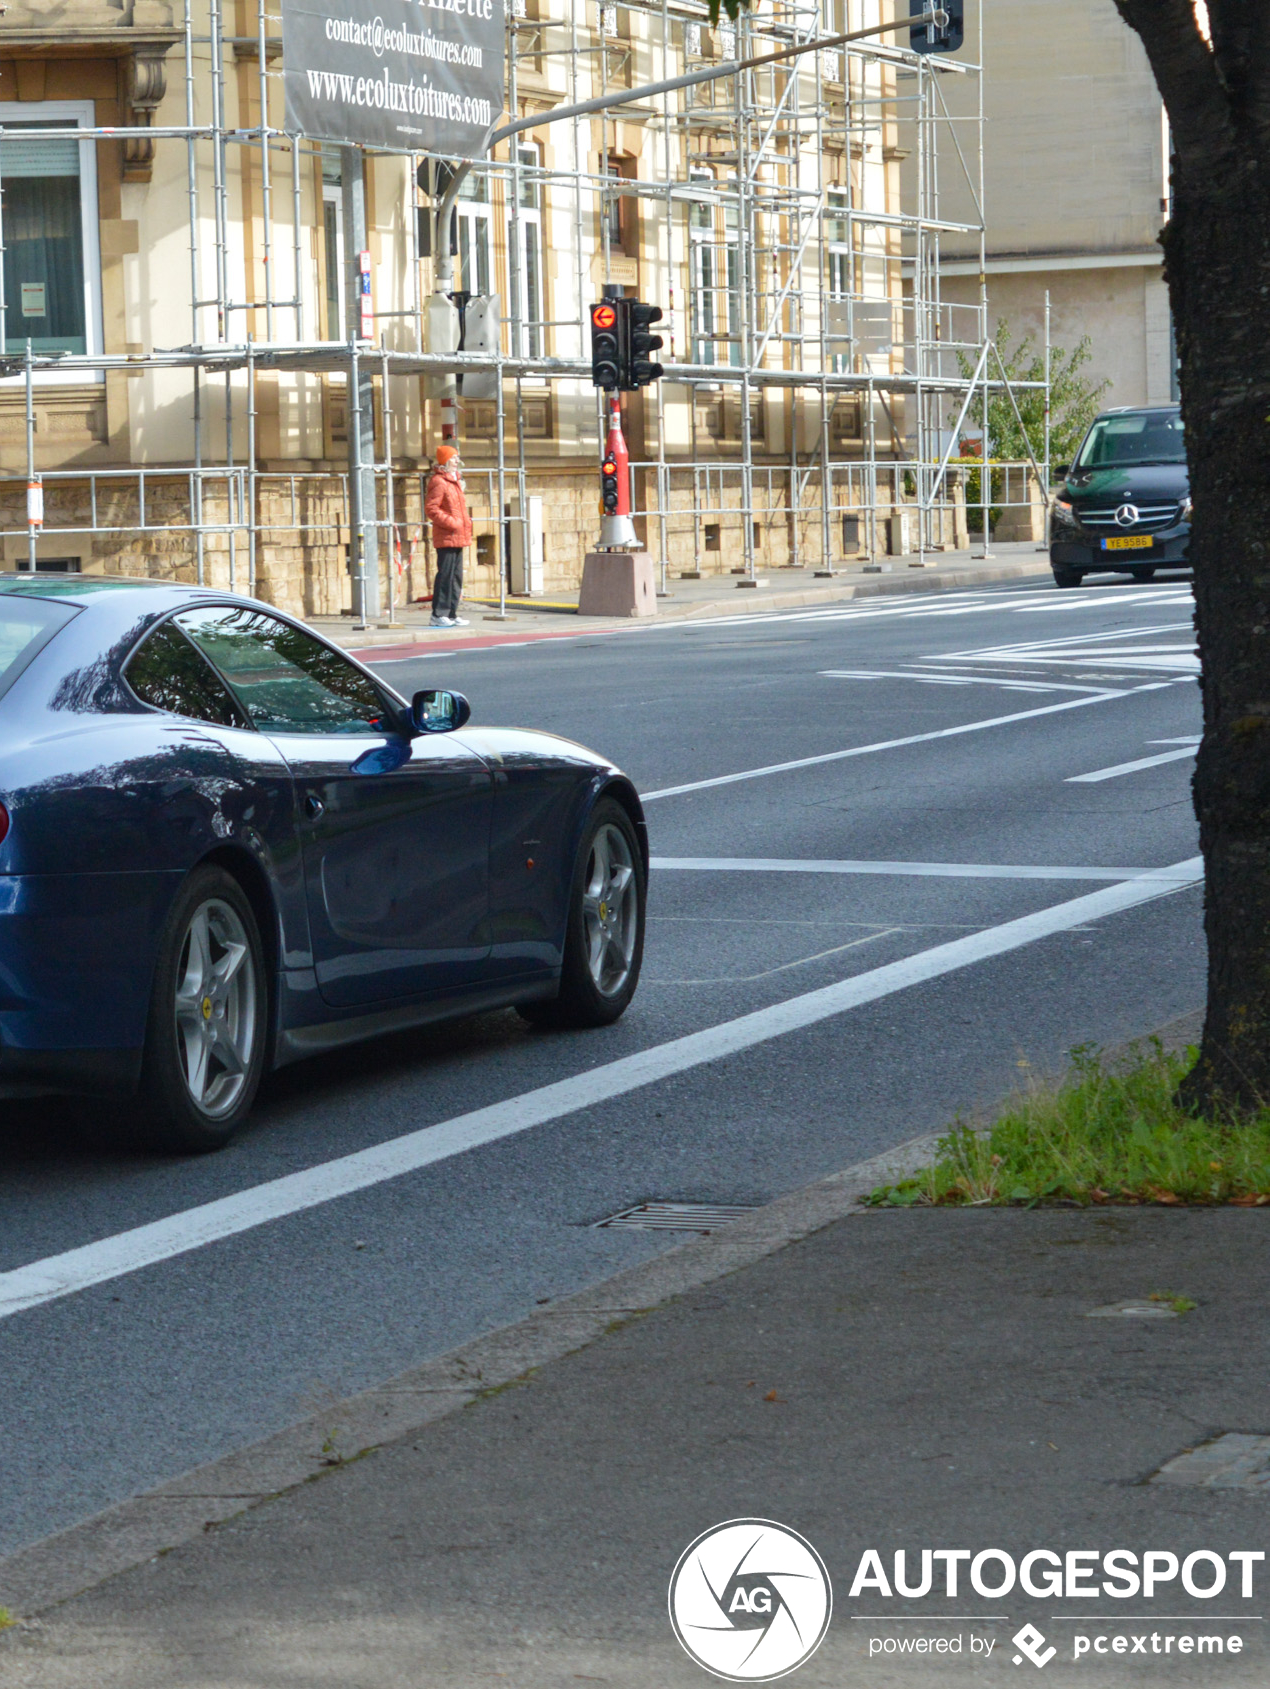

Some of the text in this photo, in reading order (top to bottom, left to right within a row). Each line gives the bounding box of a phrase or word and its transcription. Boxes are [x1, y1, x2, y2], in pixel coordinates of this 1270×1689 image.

[418, 0, 493, 20] zette
[325, 16, 483, 68] contact@ecoluxtoitures.com
[306, 67, 491, 127] www.ecoluxtoitures.com
[1123, 537, 1147, 547] 9586
